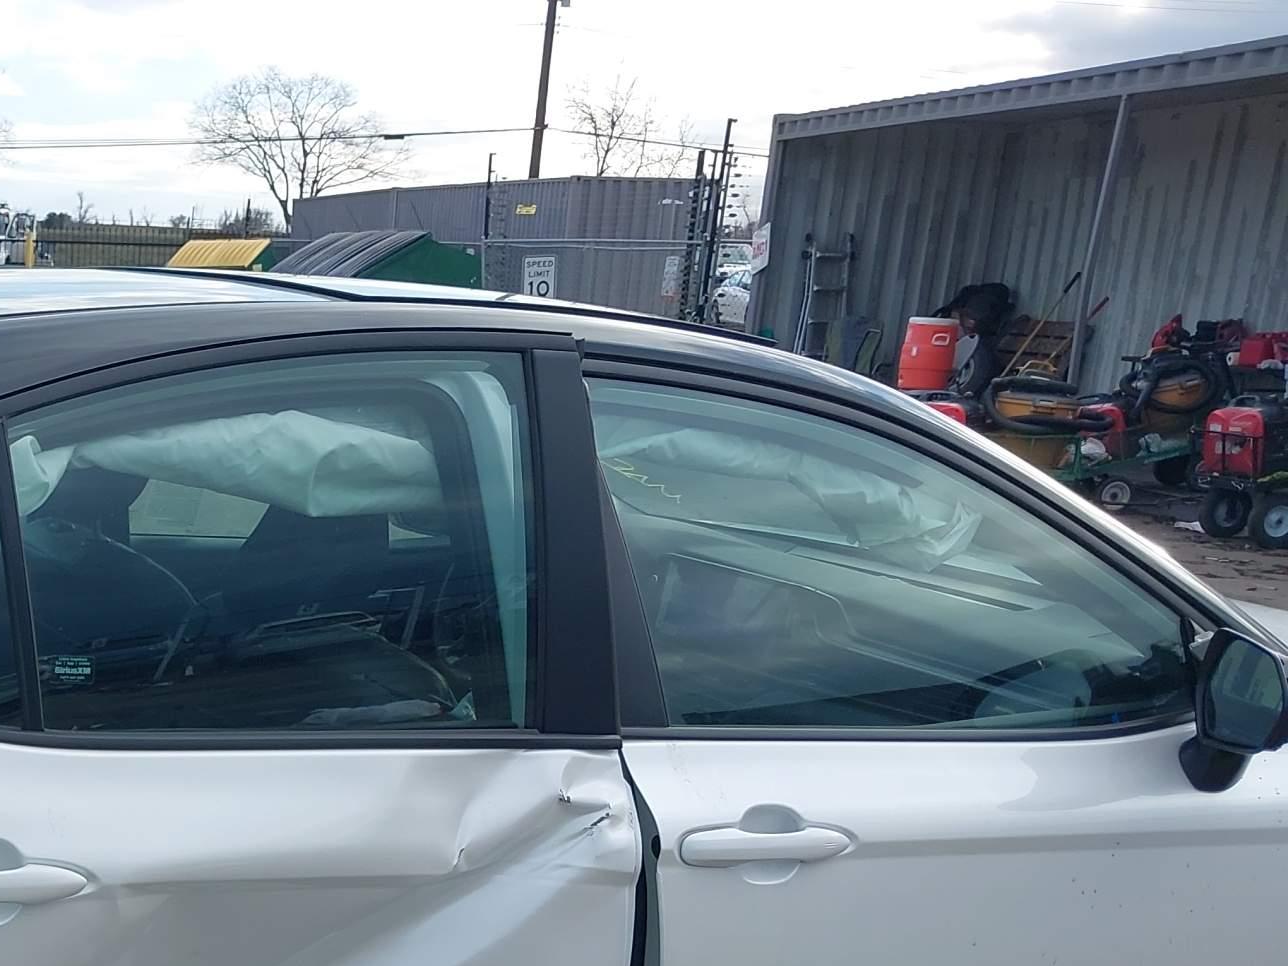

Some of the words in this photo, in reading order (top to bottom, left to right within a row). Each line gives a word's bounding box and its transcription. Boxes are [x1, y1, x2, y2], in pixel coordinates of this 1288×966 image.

[526, 260, 554, 268] SPEED
[528, 270, 550, 278] LIMIT
[528, 280, 550, 297] 10
